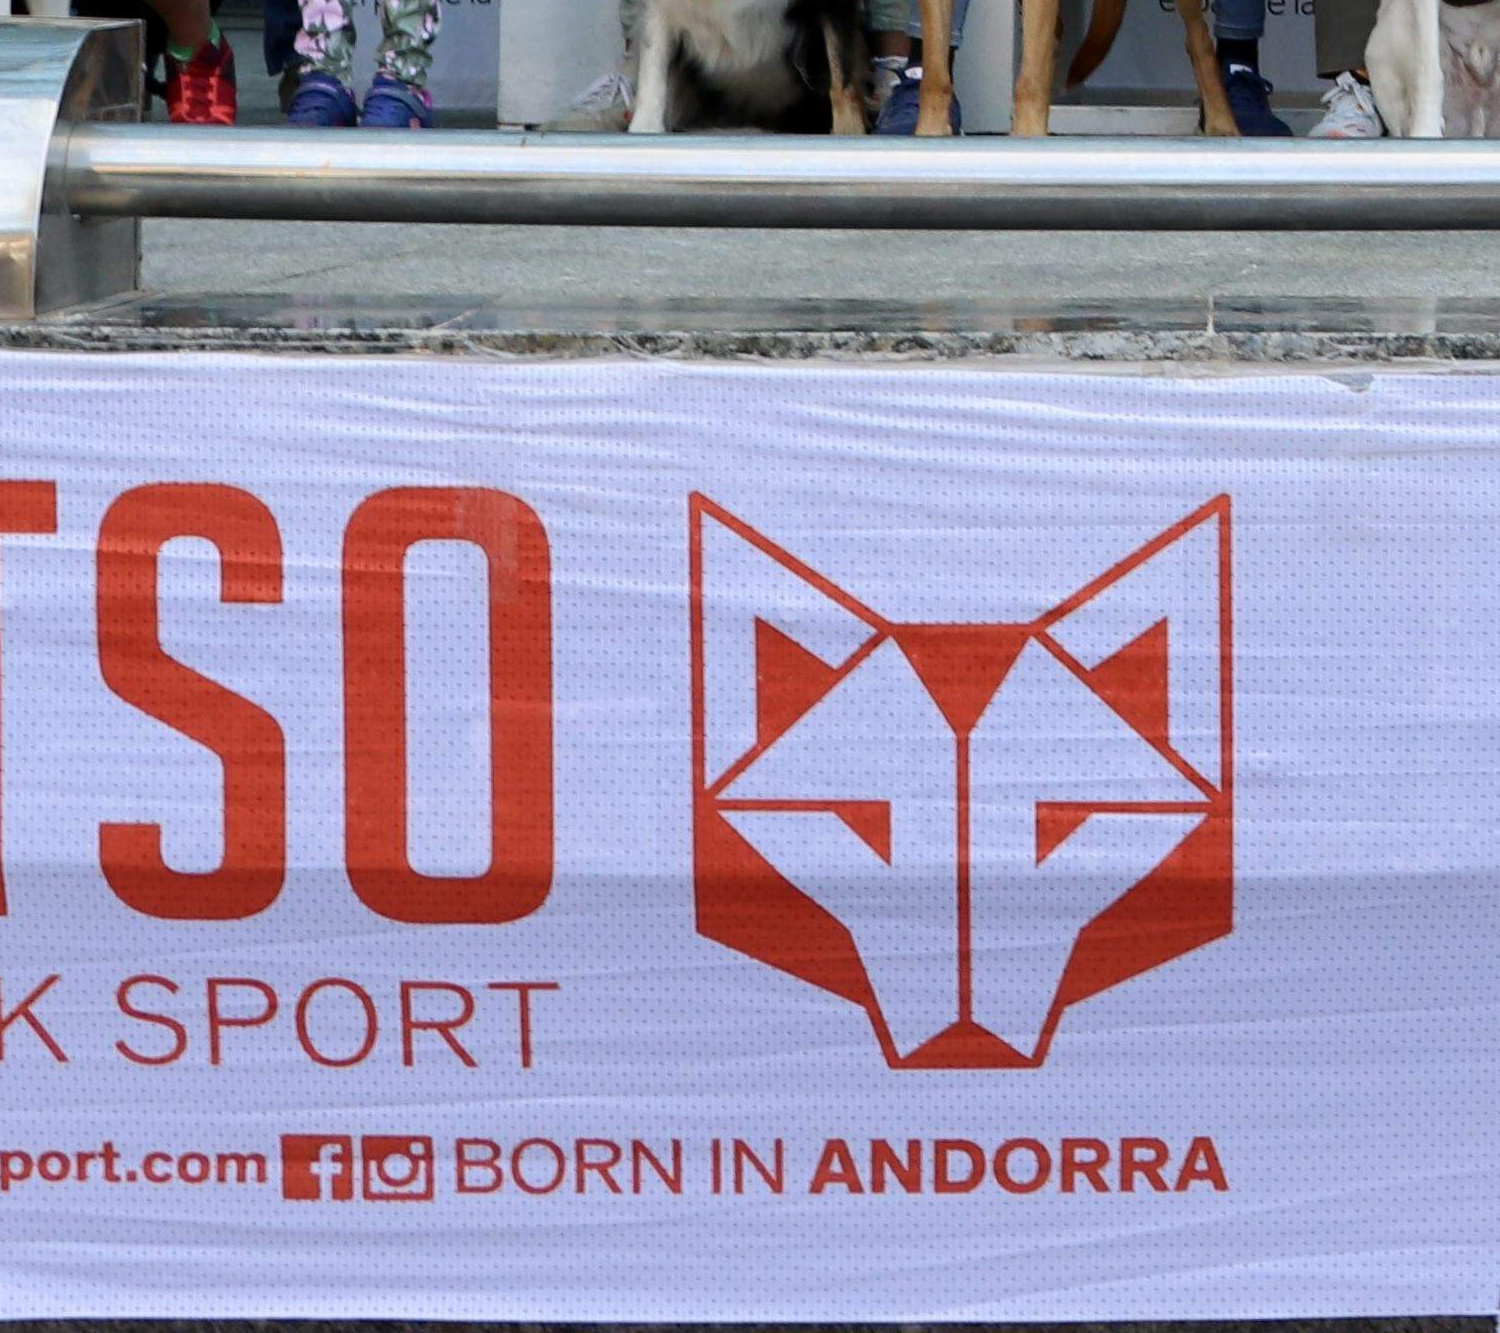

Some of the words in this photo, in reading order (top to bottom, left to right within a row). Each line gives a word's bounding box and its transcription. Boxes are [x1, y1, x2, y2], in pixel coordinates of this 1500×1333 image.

[113, 973, 561, 1069] SPORT
[454, 1136, 684, 1196] BORN
[712, 1137, 786, 1195] IN
[807, 1136, 1230, 1195] ANDORRA
